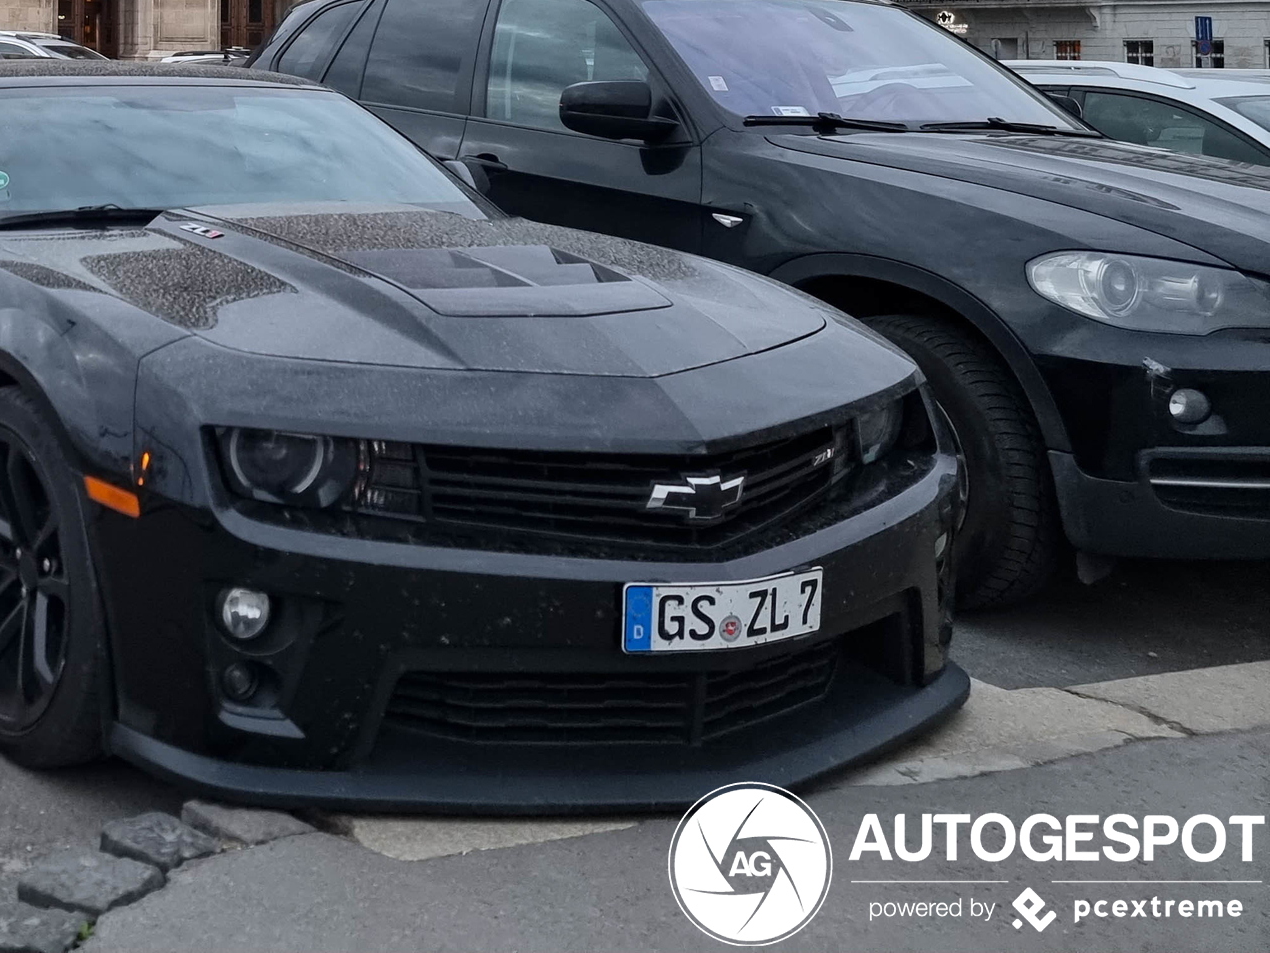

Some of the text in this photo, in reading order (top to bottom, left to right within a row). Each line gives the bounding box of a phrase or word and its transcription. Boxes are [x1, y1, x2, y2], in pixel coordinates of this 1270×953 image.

[633, 578, 819, 642] D GS ZL 7
